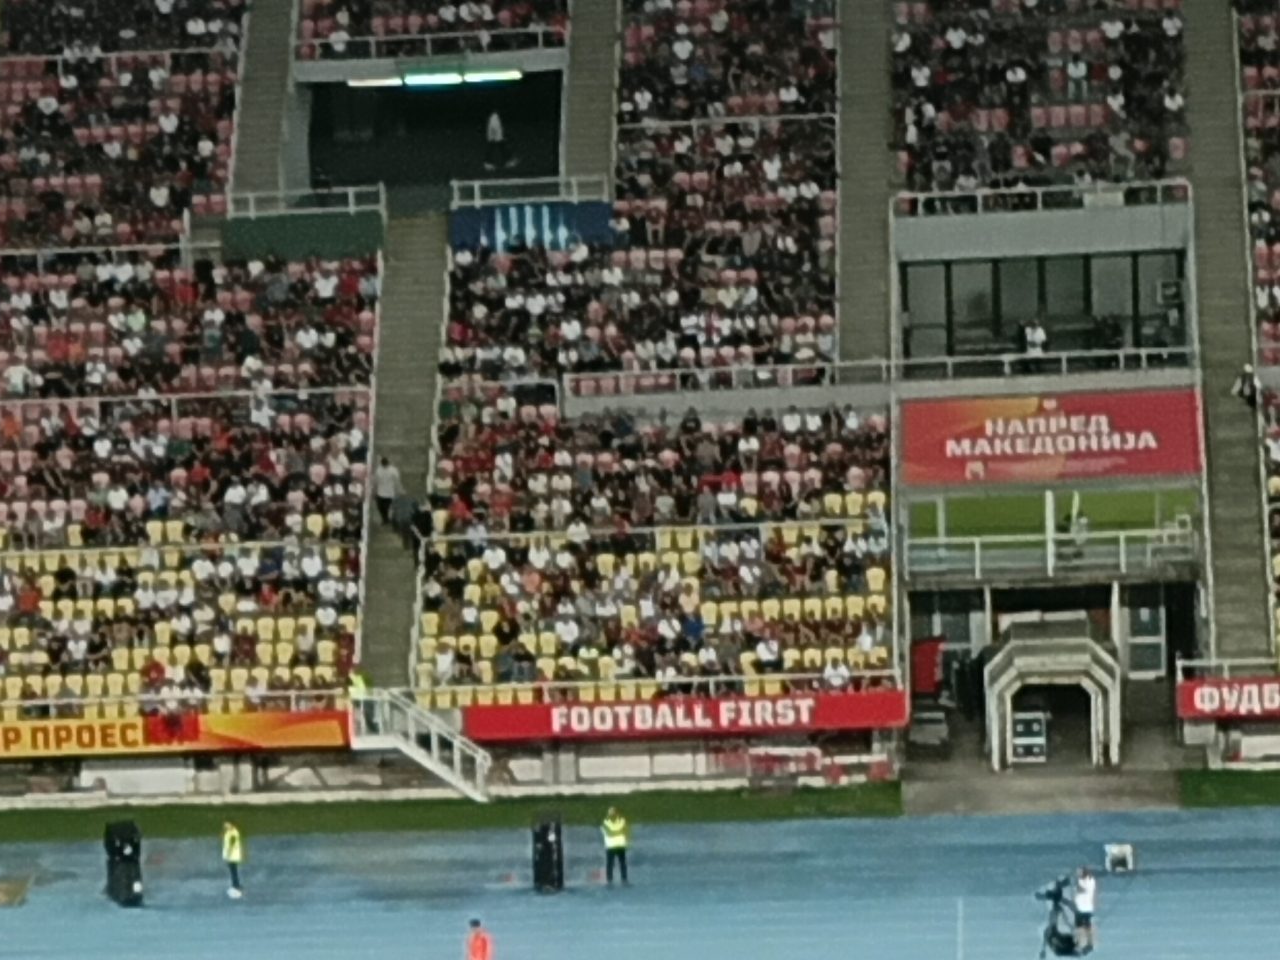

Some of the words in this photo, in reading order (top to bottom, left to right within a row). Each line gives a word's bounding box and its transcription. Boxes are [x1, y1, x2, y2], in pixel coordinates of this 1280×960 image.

[985, 414, 1111, 437] НАПРЕД
[945, 430, 1158, 458] МАКЕДОНИЈА
[550, 703, 713, 733] FOOTBALL
[719, 697, 816, 727] FIRST
[30, 721, 185, 751] ПРОЕС
